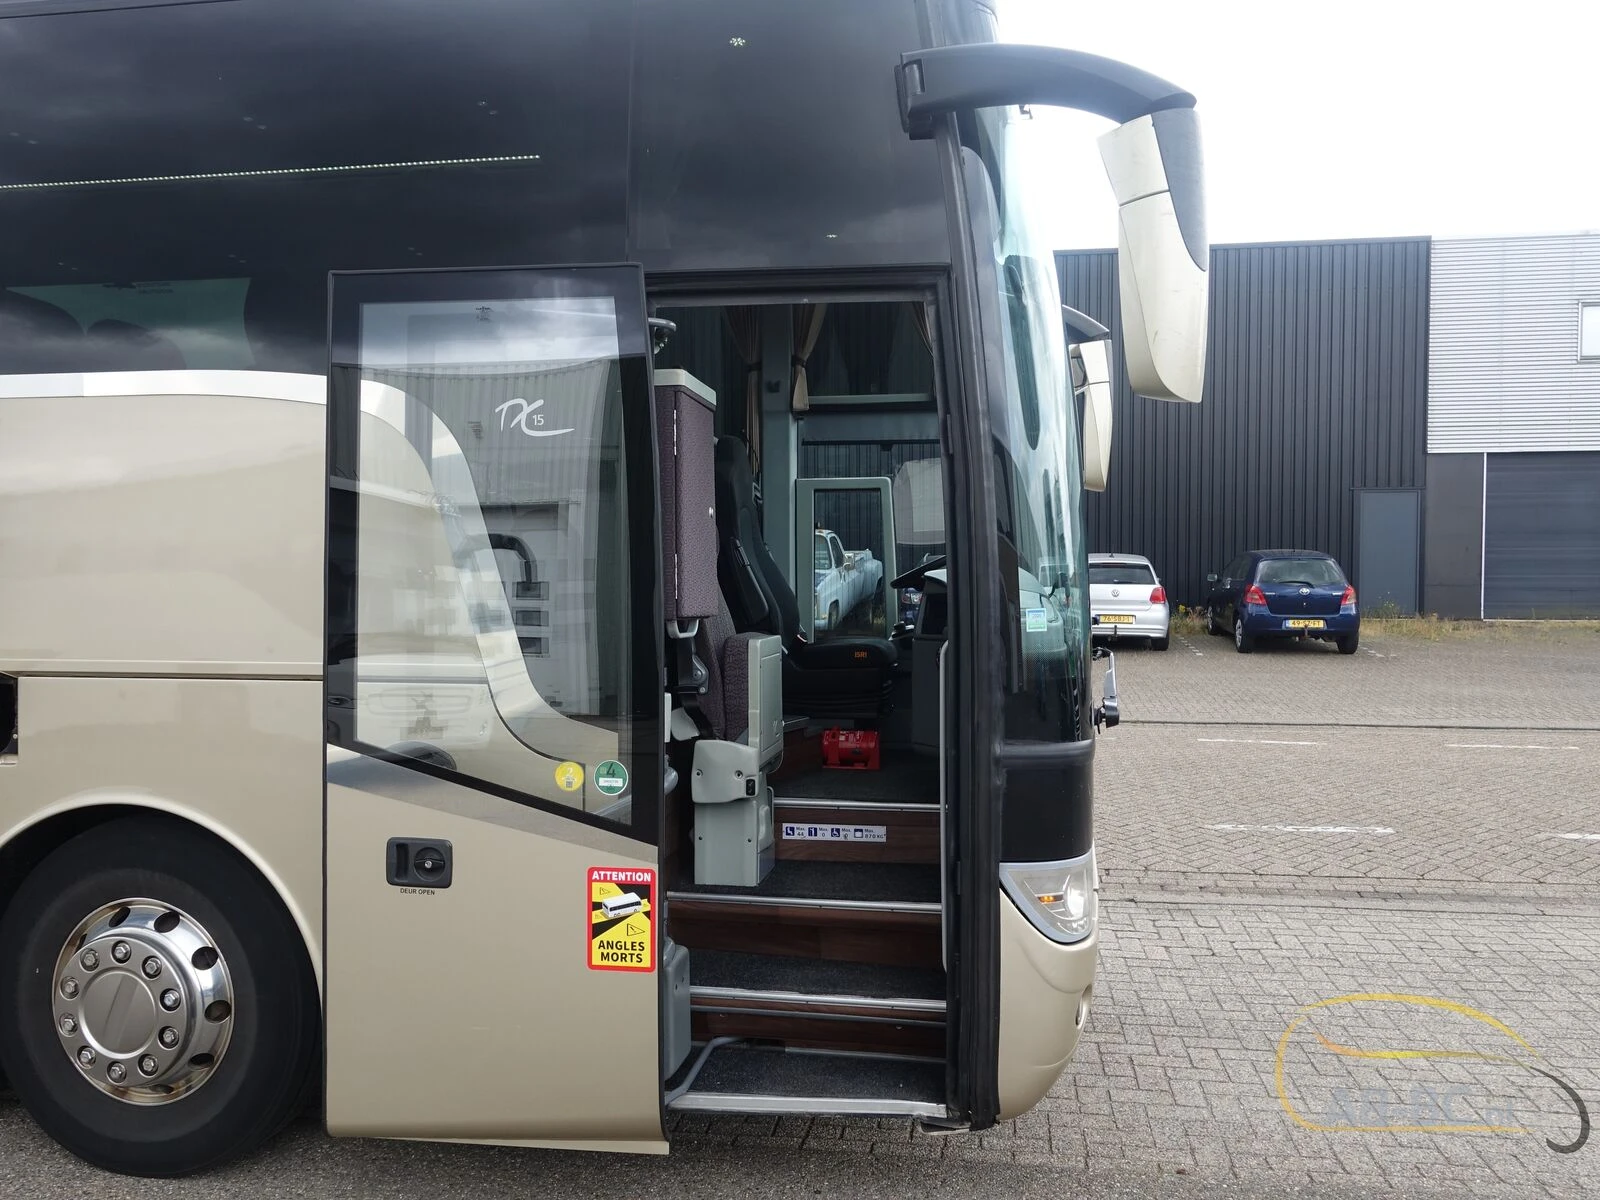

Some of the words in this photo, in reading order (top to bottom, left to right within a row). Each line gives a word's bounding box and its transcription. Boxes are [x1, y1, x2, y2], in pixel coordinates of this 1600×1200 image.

[532, 414, 544, 426] 15
[606, 763, 616, 777] 4
[592, 871, 651, 882] ATTENTION
[598, 940, 645, 952] ANGLES
[600, 952, 643, 963] MORTS
